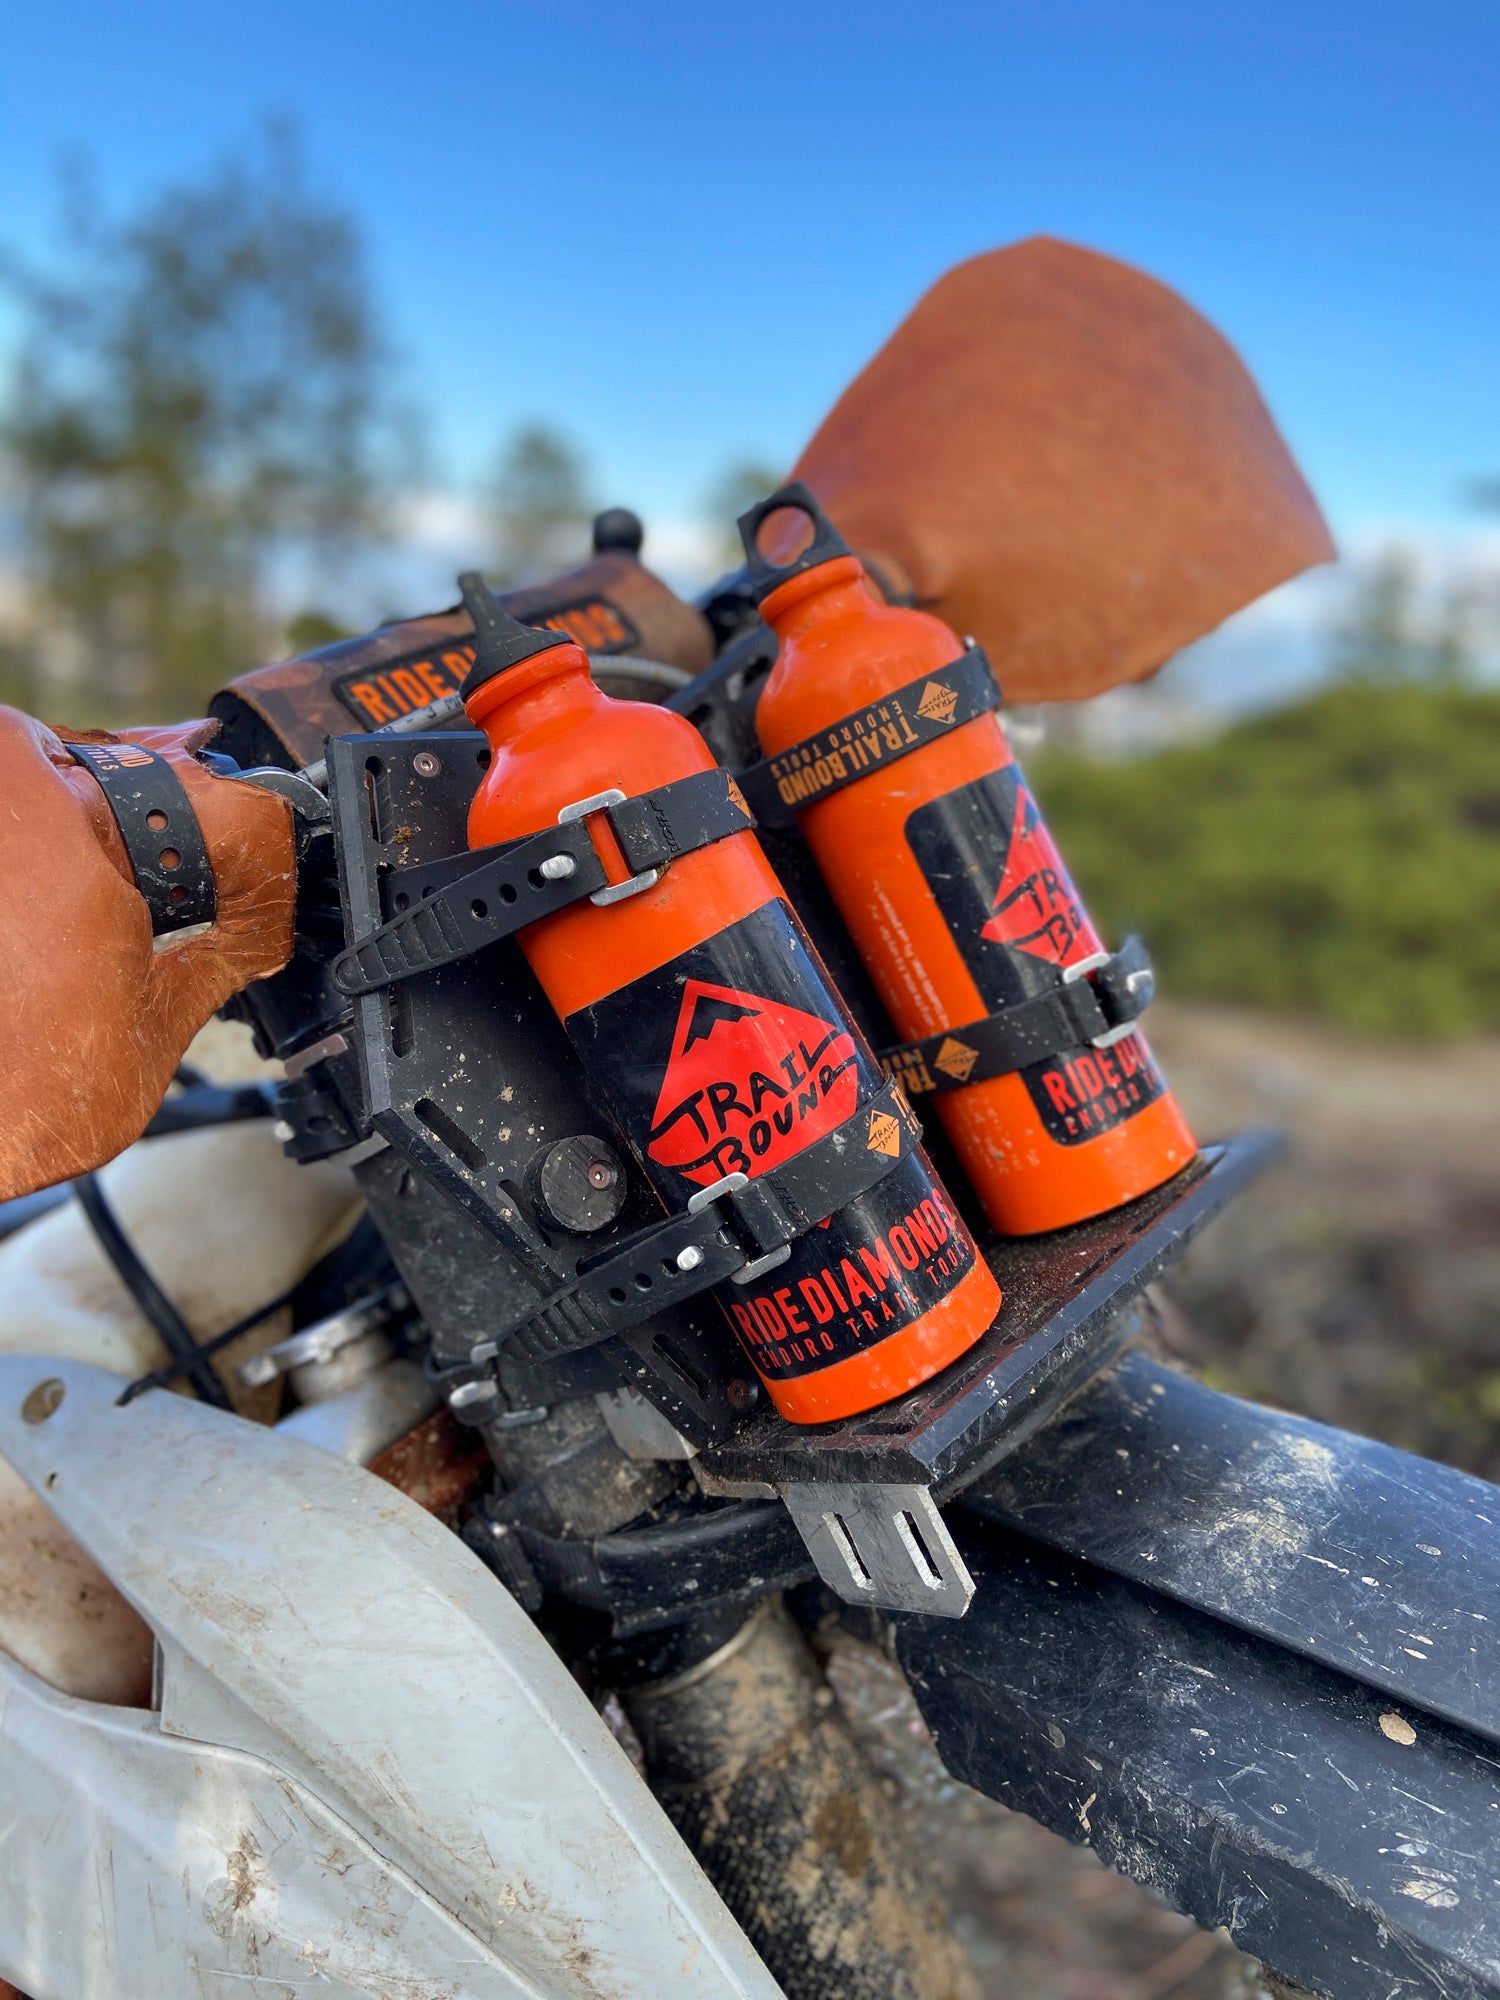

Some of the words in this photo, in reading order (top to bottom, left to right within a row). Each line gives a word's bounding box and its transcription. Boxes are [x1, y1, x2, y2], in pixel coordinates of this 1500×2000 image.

[350, 660, 456, 724] RIDE
[828, 700, 902, 748] ENDURO
[770, 742, 823, 779] TOOLS
[651, 1026, 842, 1143] TRAIL
[678, 1056, 856, 1181] BOUND
[1042, 1048, 1122, 1114] RIDE
[731, 1287, 809, 1346] RIDE
[797, 1187, 957, 1325] DIAMONDS
[757, 1331, 835, 1369] ENDURO
[845, 1290, 919, 1338] TRAIL
[925, 1233, 970, 1286] TOOLS
